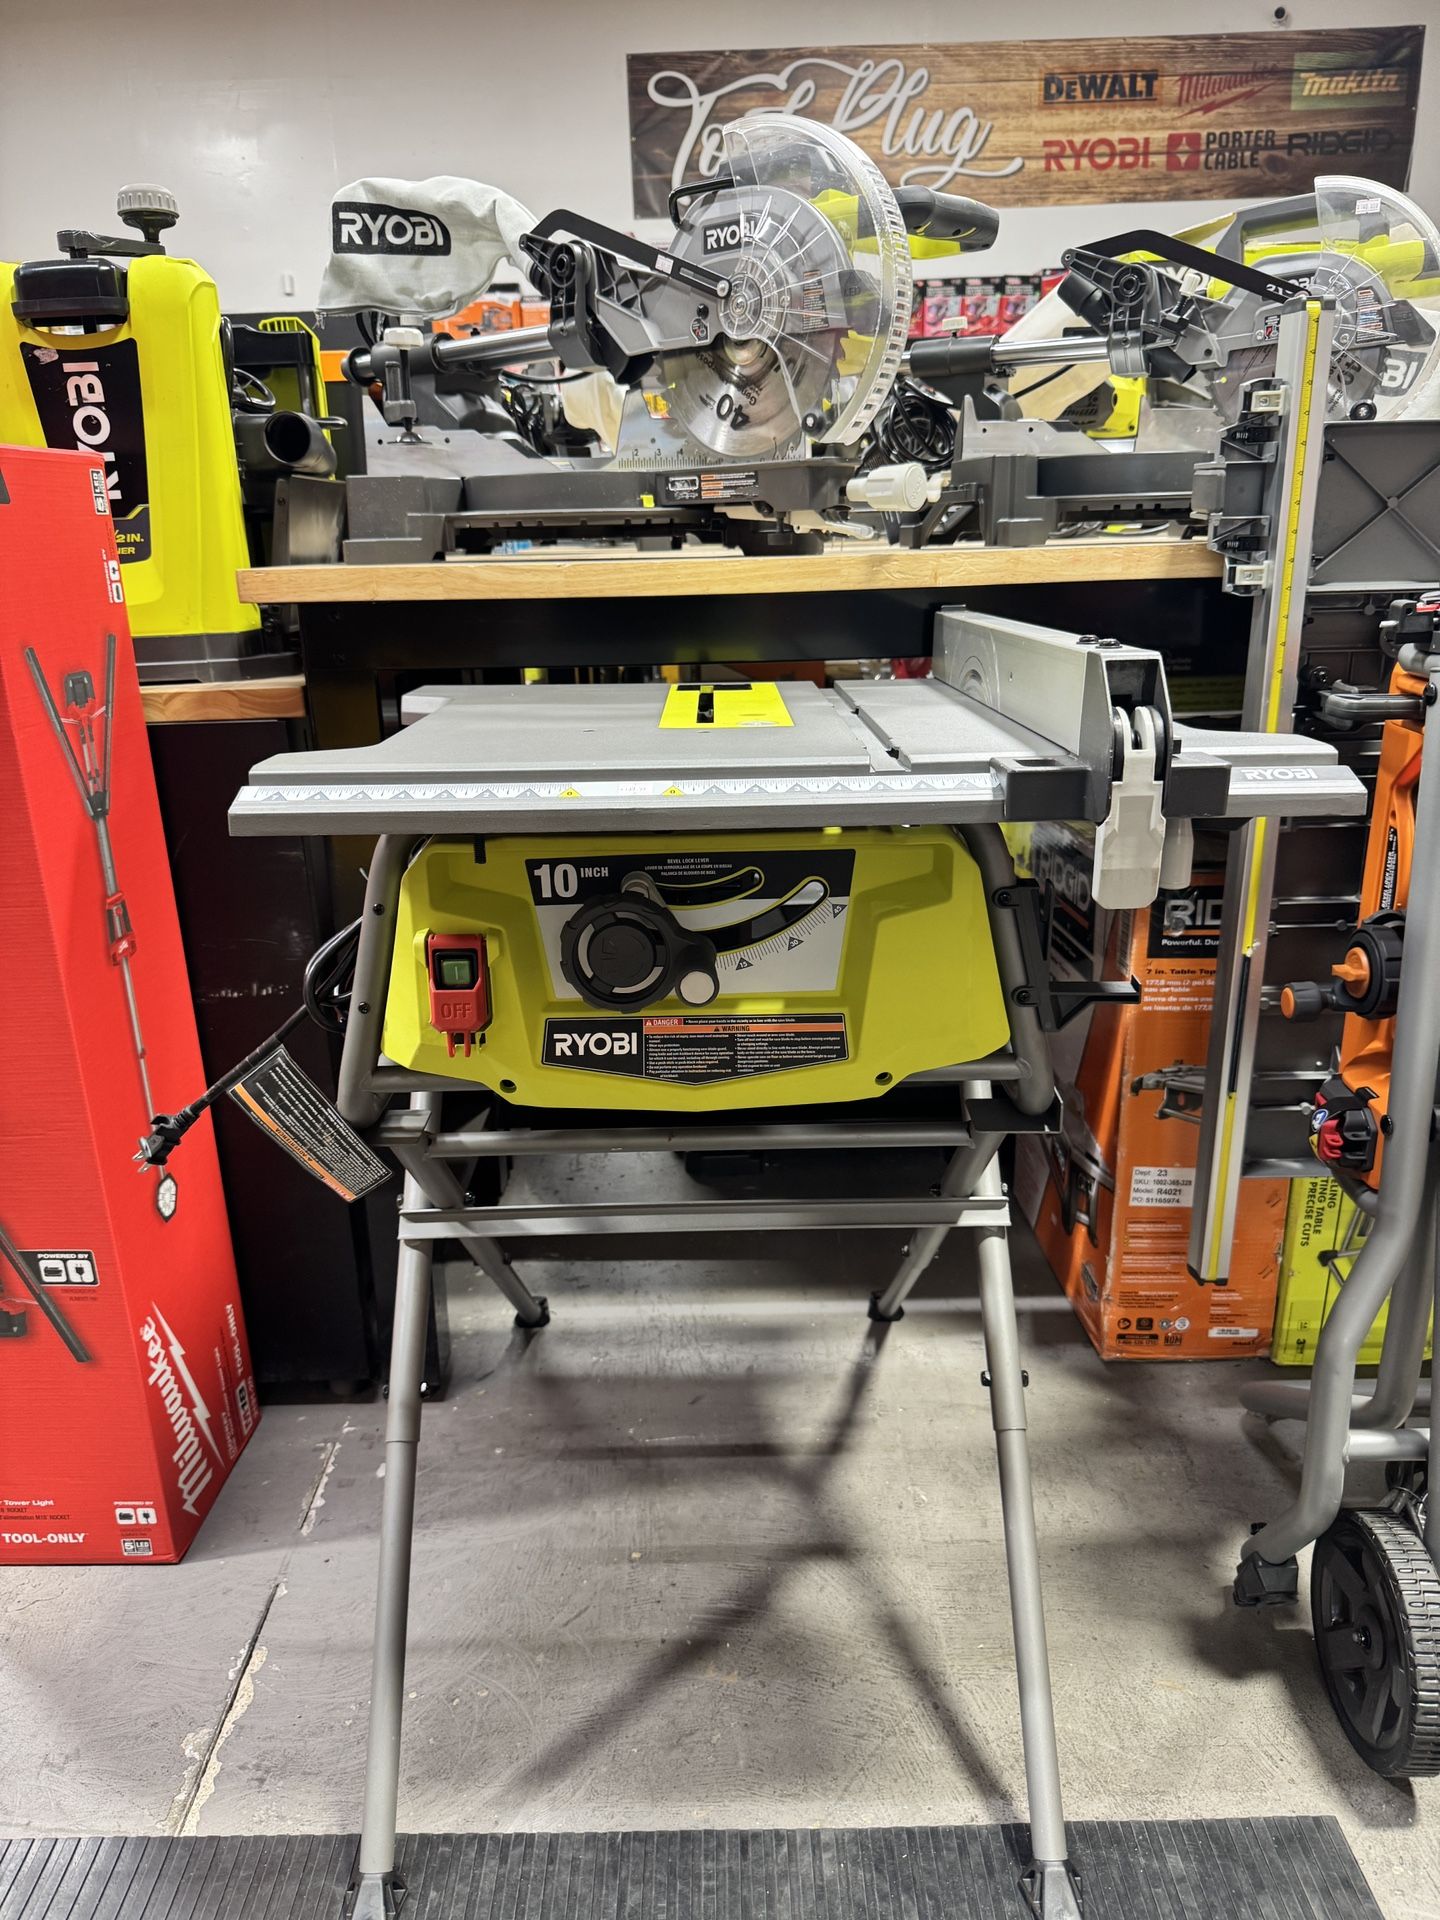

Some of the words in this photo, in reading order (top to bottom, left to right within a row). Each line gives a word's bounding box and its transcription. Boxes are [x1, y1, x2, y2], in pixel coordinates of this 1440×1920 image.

[779, 58, 1023, 192] Plug
[1205, 130, 1276, 149] PORTER
[1287, 128, 1394, 156] RIDGID
[1043, 137, 1150, 172] RYOBI
[1204, 152, 1260, 171] CABLE
[338, 212, 444, 246] RYOBI
[705, 219, 754, 250] RYOBI
[716, 394, 750, 431] 40
[127, 533, 144, 543] IN.
[1240, 767, 1319, 780] RYOBI
[534, 863, 578, 898] 10
[580, 866, 609, 878] INCH
[1039, 848, 1091, 912] RIDGID
[833, 905, 843, 913] 45
[1163, 898, 1222, 926] RID
[1161, 938, 1202, 946] Powerful.
[440, 1003, 473, 1019] OFF
[553, 1032, 638, 1056] RYOBI
[1157, 1169, 1167, 1177] 23
[1157, 1188, 1182, 1196] R4021
[1303, 1181, 1318, 1220] PRECISE
[1312, 1206, 1325, 1235] TABLE
[1300, 1222, 1312, 1248] CUTS
[226, 1304, 244, 1377] TOOL-ONLY
[140, 1316, 214, 1516] Milwaukee
[32, 1499, 54, 1507] Light
[1, 1533, 85, 1544] TOOL-ONLY
